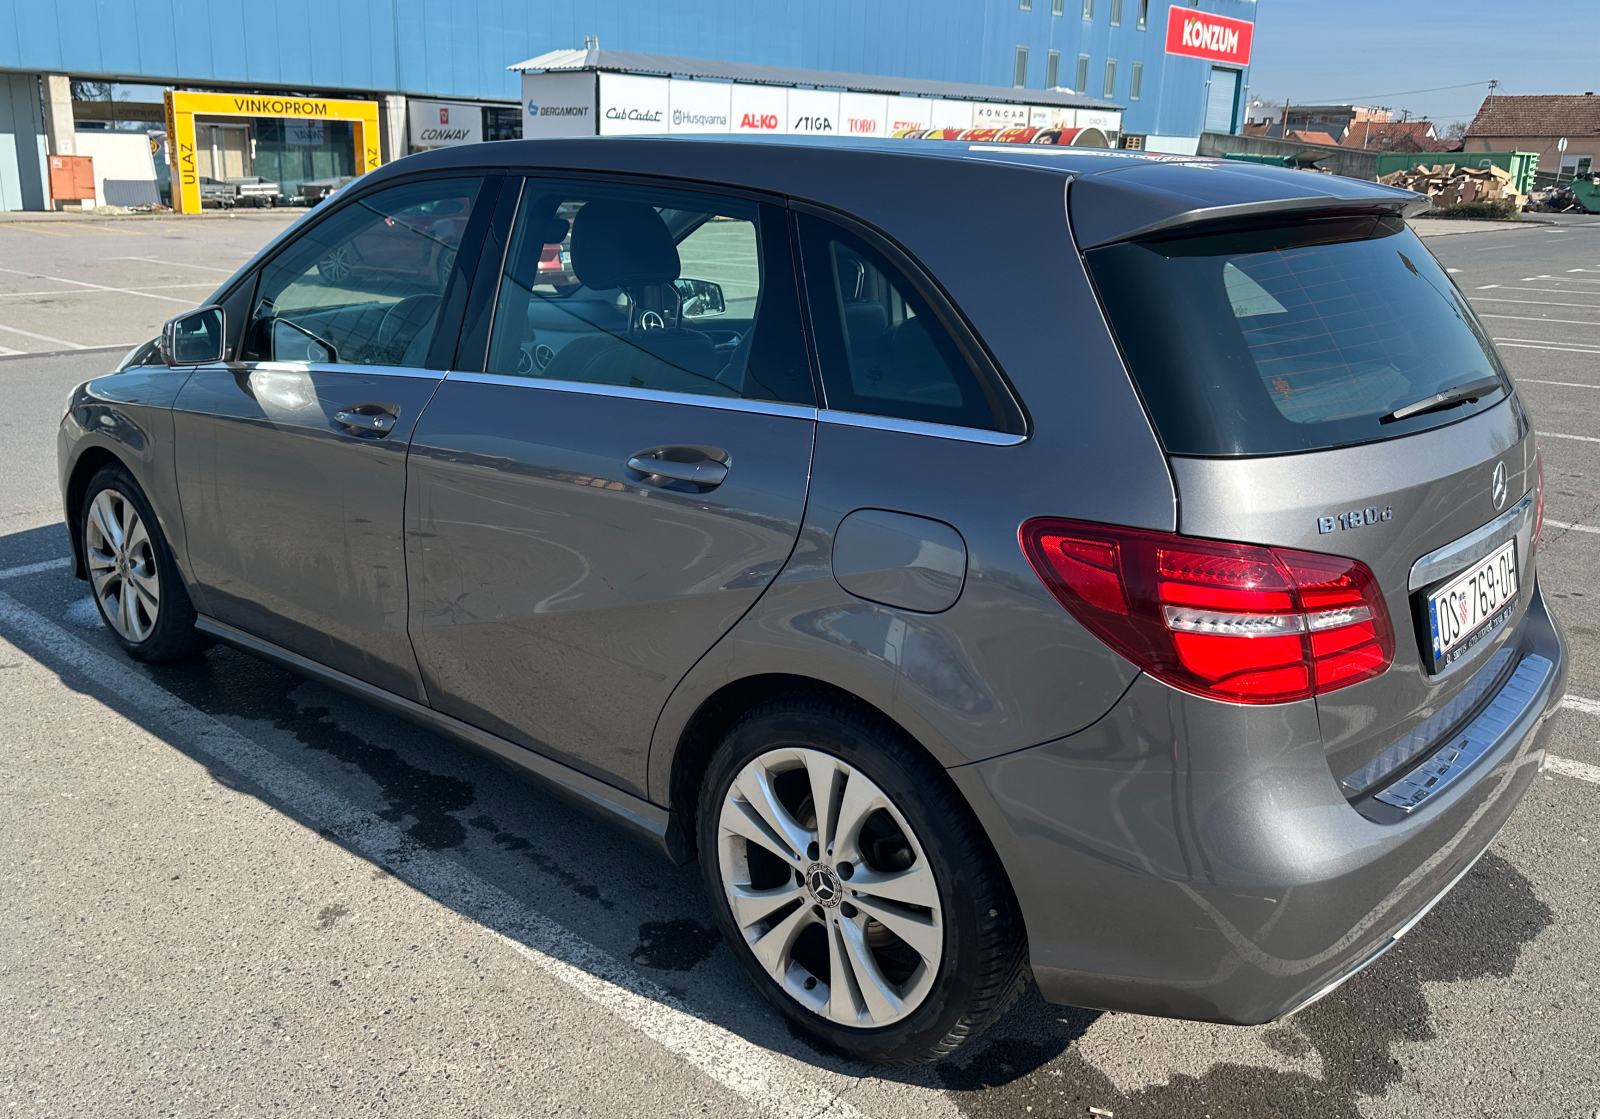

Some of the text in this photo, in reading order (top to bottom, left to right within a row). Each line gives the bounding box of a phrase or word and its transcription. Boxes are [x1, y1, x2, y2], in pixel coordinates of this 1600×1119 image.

[1182, 19, 1239, 54] KONZUM
[234, 98, 327, 115] VINKOPROM
[606, 107, 662, 122] Cub Cadet
[683, 111, 726, 126] Husqvarna
[848, 118, 876, 133] TORO
[420, 129, 470, 141] CONWAY
[181, 143, 196, 185] ULAZ
[1317, 516, 1336, 534] B
[1440, 591, 1460, 646] OS
